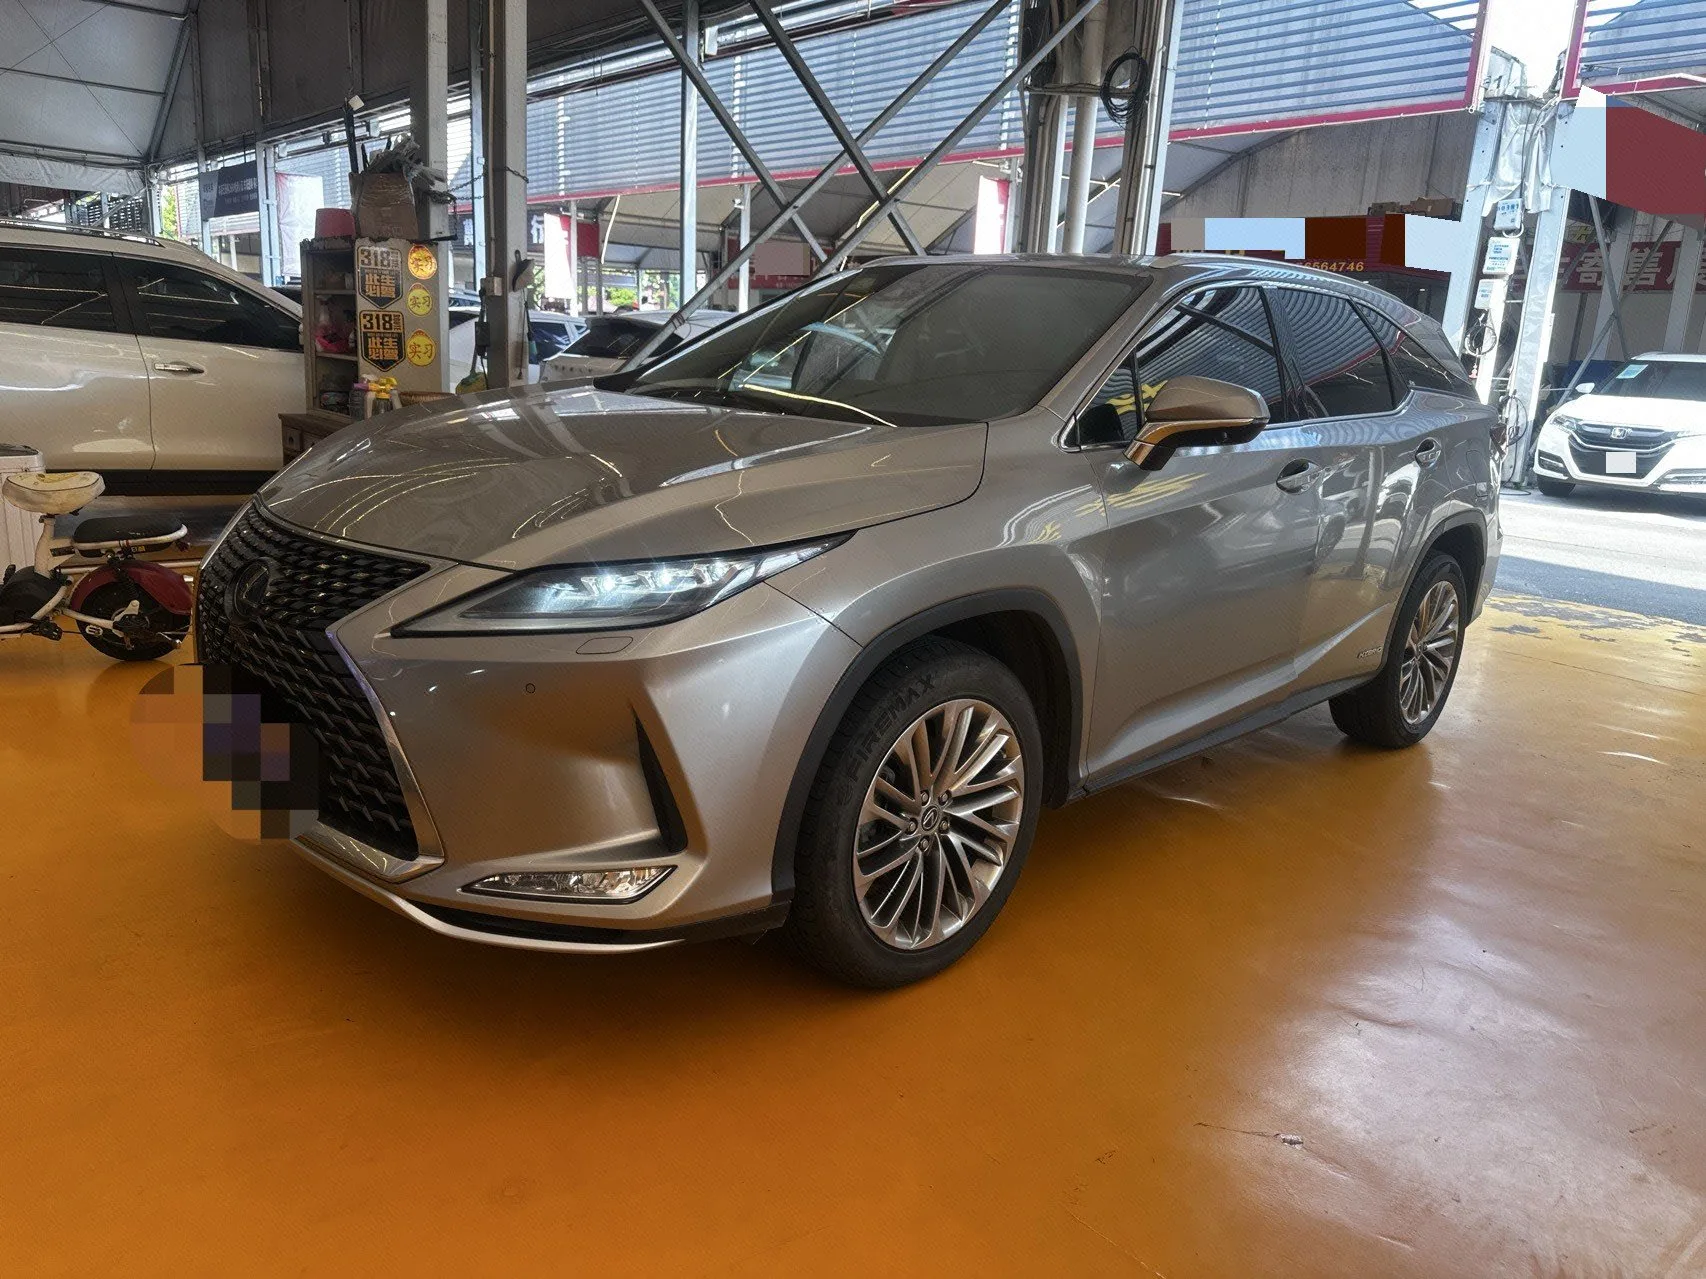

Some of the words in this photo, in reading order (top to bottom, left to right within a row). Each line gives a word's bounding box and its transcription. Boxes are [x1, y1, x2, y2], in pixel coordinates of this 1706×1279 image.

[361, 248, 391, 267] 318
[409, 296, 431, 308] 实习
[363, 313, 393, 330] 318
[368, 337, 398, 348] 此生
[409, 343, 433, 359] 实习
[846, 676, 935, 782] FIREMAX
